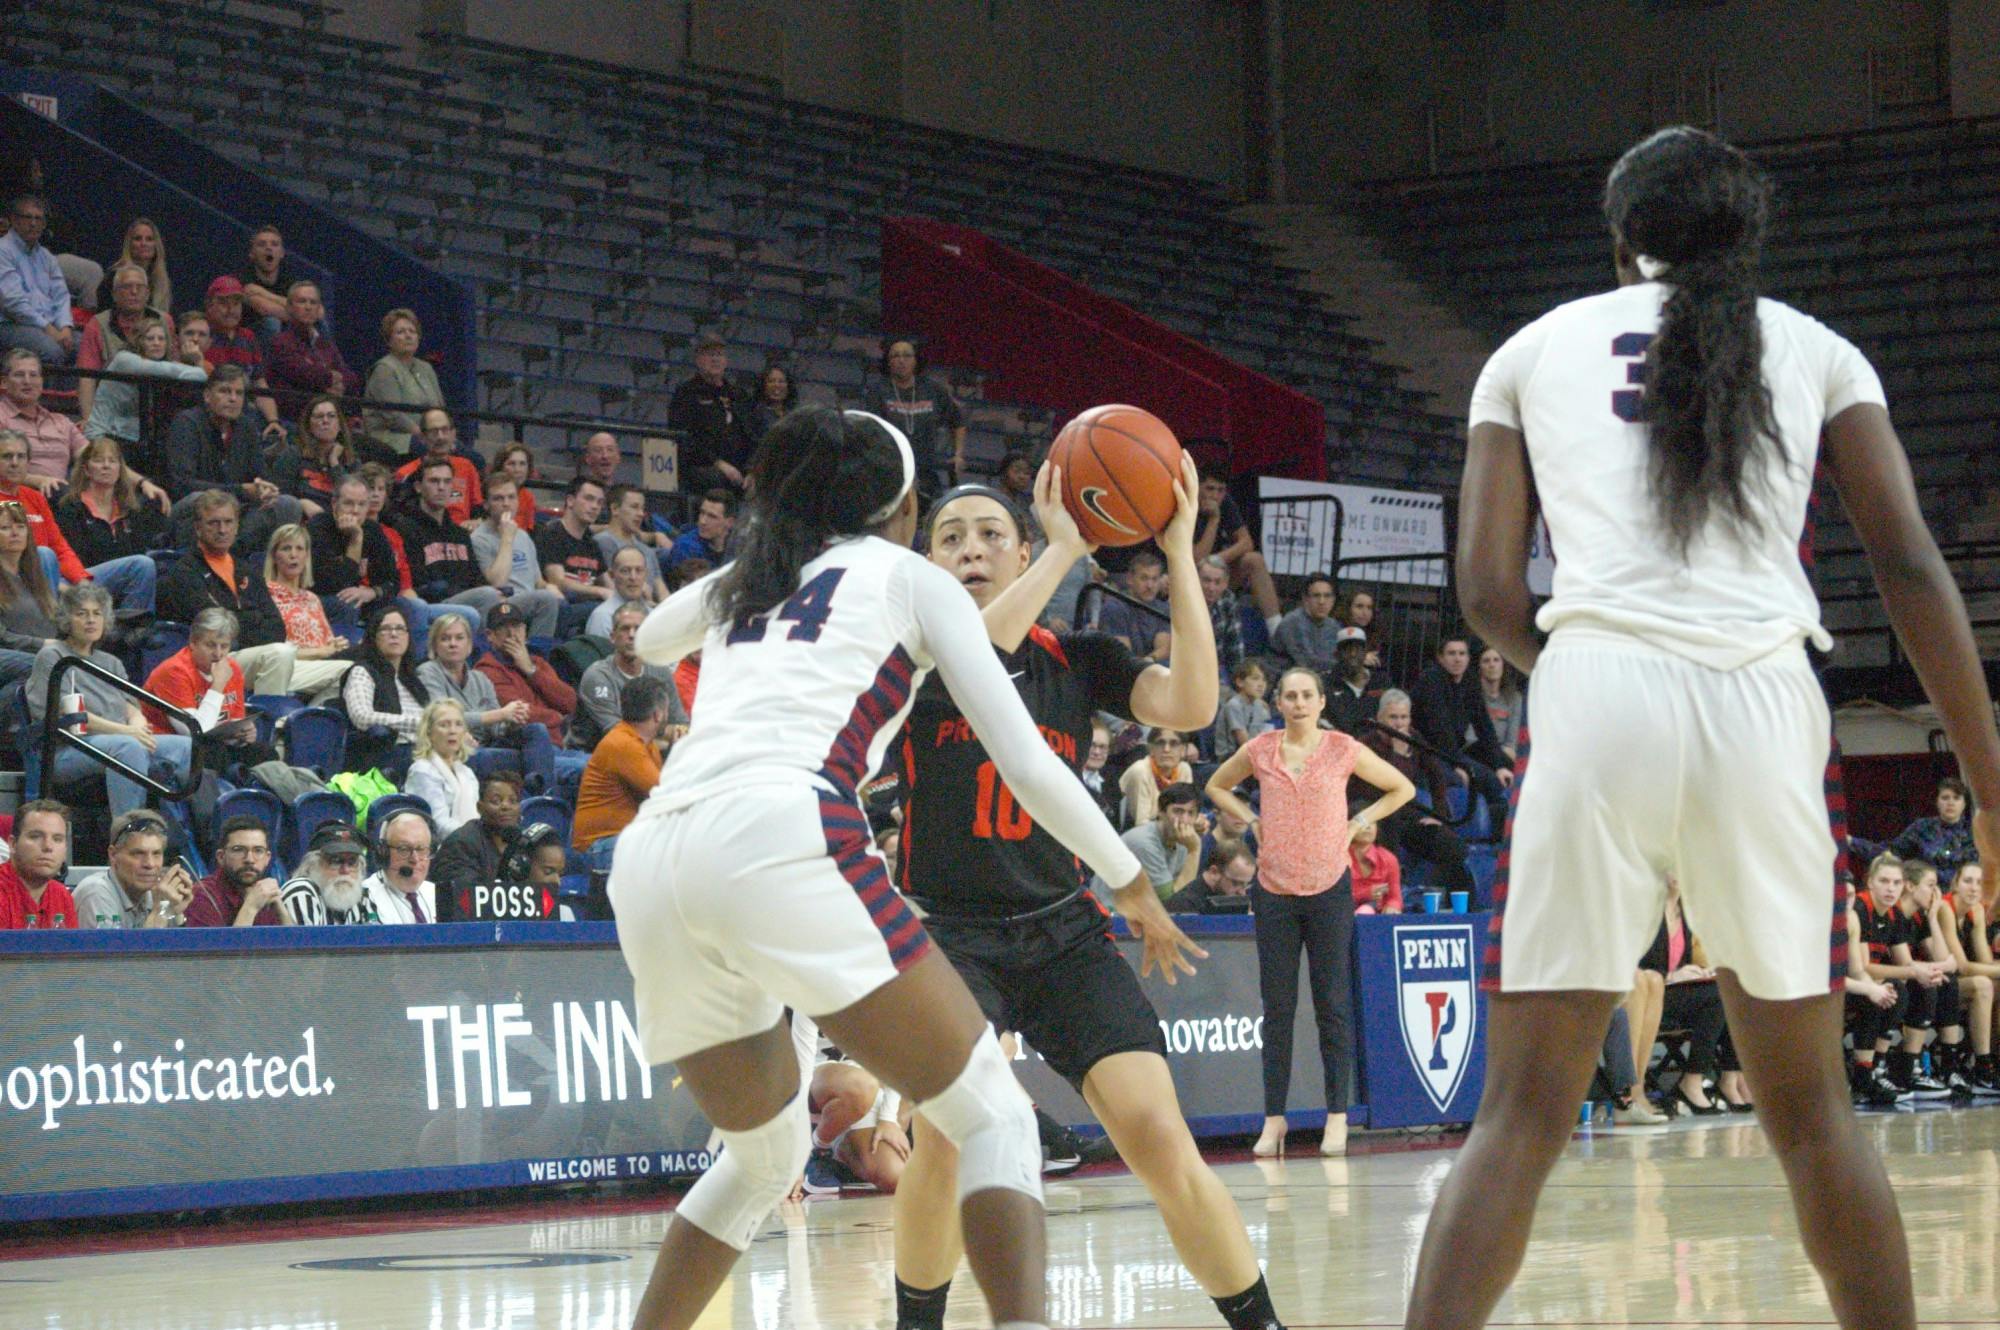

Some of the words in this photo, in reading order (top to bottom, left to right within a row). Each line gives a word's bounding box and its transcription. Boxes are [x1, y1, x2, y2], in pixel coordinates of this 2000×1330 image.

[1612, 332, 1663, 423] 3
[649, 454, 673, 474] 104
[475, 885, 541, 918] POSS.
[1402, 938, 1466, 970] PENN
[406, 1003, 533, 1110] THE
[553, 1000, 653, 1104] INN
[0, 1026, 336, 1130] ophisticated.
[528, 1156, 617, 1181] WELCOME
[627, 1155, 650, 1175] TO
